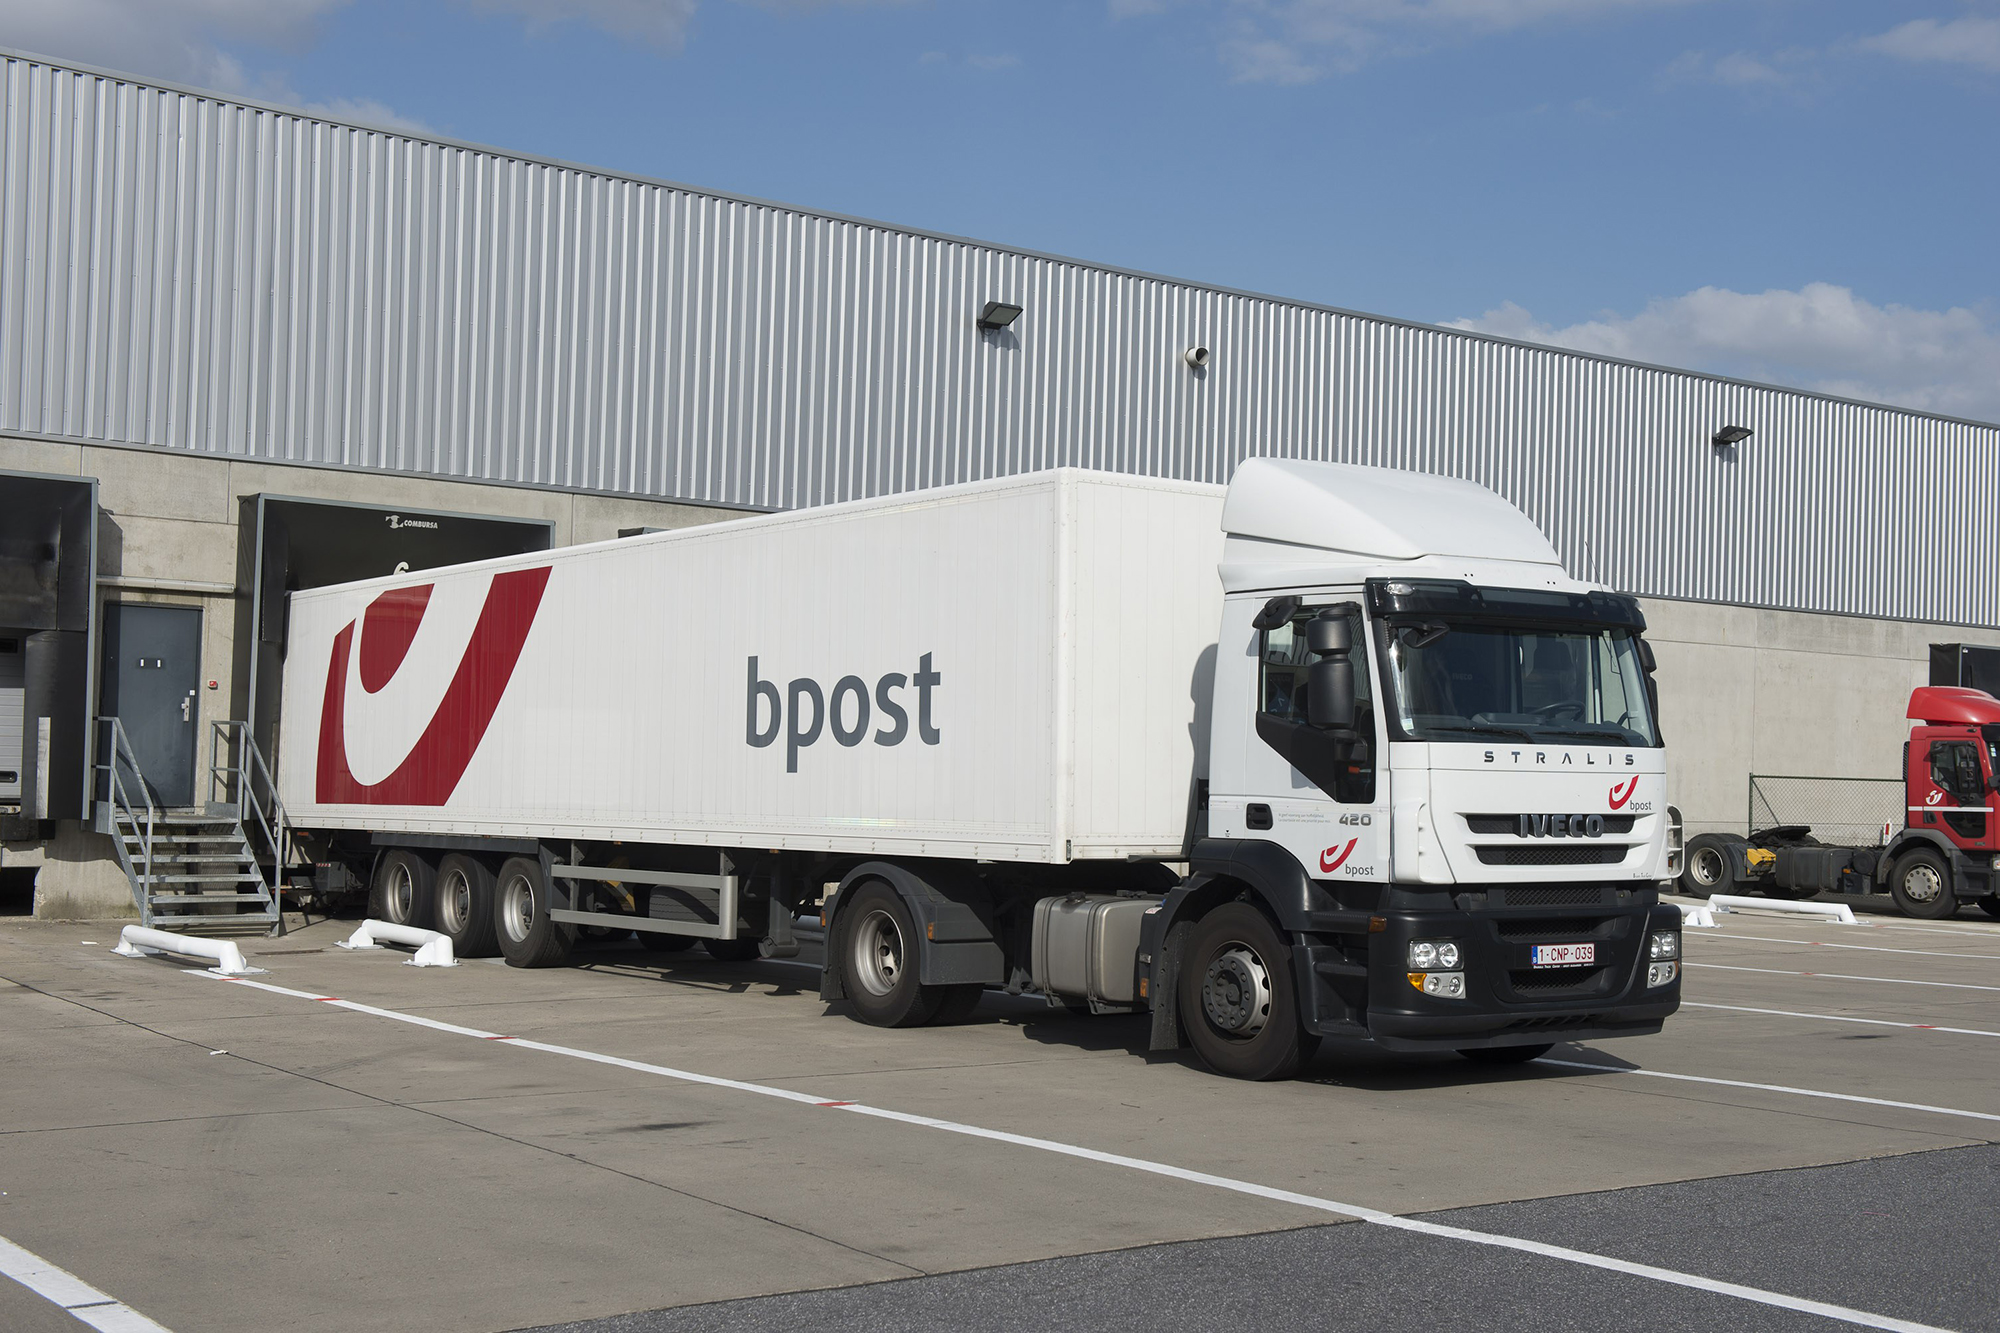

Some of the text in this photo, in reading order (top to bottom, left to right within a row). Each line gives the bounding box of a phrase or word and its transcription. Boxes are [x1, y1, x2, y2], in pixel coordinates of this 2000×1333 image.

[404, 520, 438, 529] COMBURSA
[746, 651, 941, 773] bpost
[1484, 751, 1634, 766] STRALIS
[1630, 800, 1652, 812] bpost
[1339, 813, 1371, 826] 420
[1520, 814, 1604, 838] IVECO
[1345, 864, 1374, 877] bpost
[1540, 946, 1593, 962] 1-CNP-039
